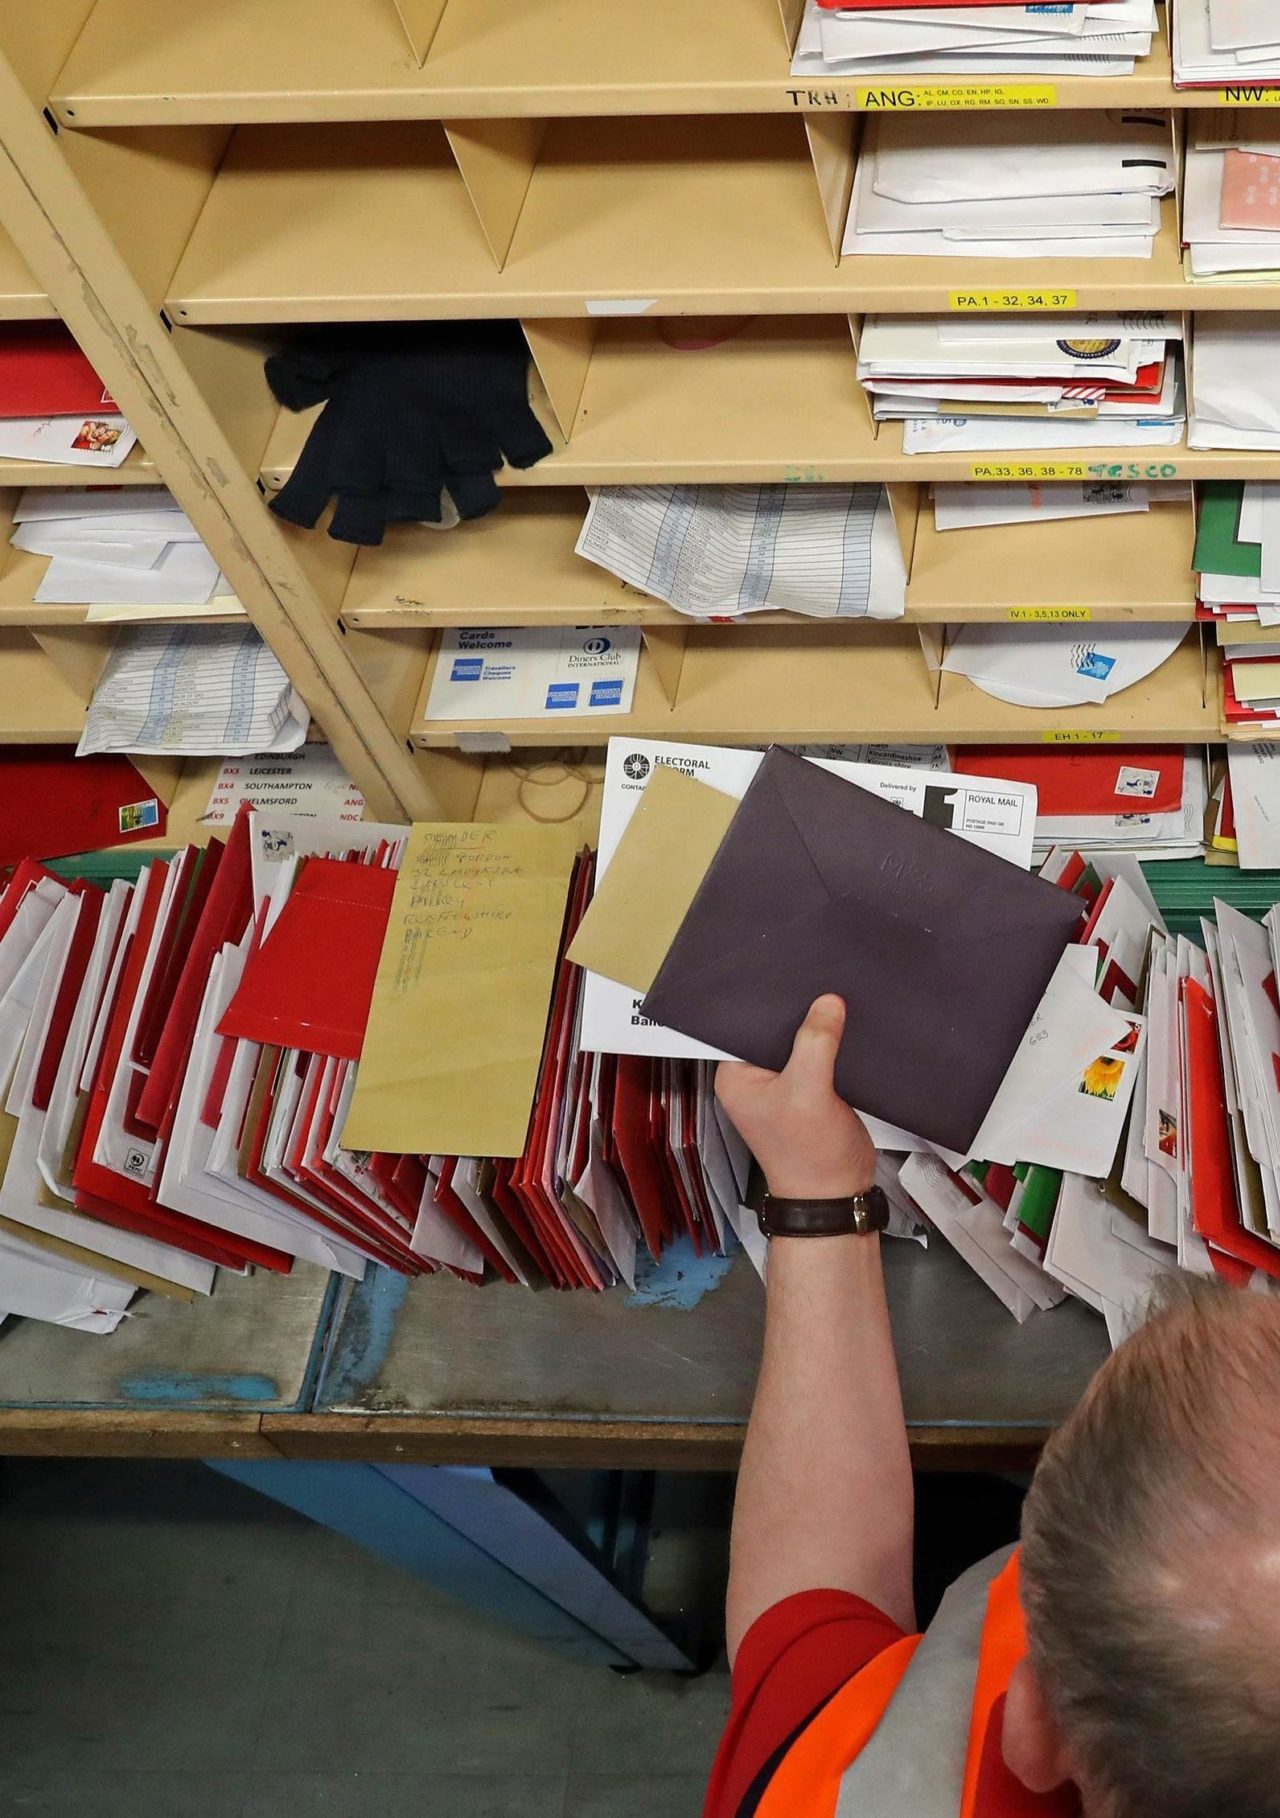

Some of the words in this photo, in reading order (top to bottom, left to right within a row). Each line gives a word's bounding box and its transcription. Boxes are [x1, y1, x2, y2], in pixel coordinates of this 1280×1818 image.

[865, 90, 921, 107] ANG:
[1225, 86, 1269, 102] NW:
[957, 296, 989, 306] PA.1
[1002, 295, 1023, 307] 32,
[1027, 295, 1048, 307] 34,
[1051, 295, 1068, 305] 37
[1018, 466, 1037, 477] 36,
[1040, 466, 1056, 476] 38
[1067, 466, 1083, 476] 78
[1061, 610, 1086, 618] ONLY
[460, 631, 495, 641] Cards
[458, 641, 512, 650] Welcome
[568, 655, 599, 663] Diners
[600, 652, 622, 662] Club
[869, 750, 922, 762] Kincardineshire
[654, 755, 711, 770] ELECTORAL
[223, 767, 240, 775] BX3
[249, 767, 292, 775] LEICESTER
[880, 782, 908, 791] Delivered
[968, 794, 995, 805] ROYAL
[998, 798, 1018, 807] MAIL
